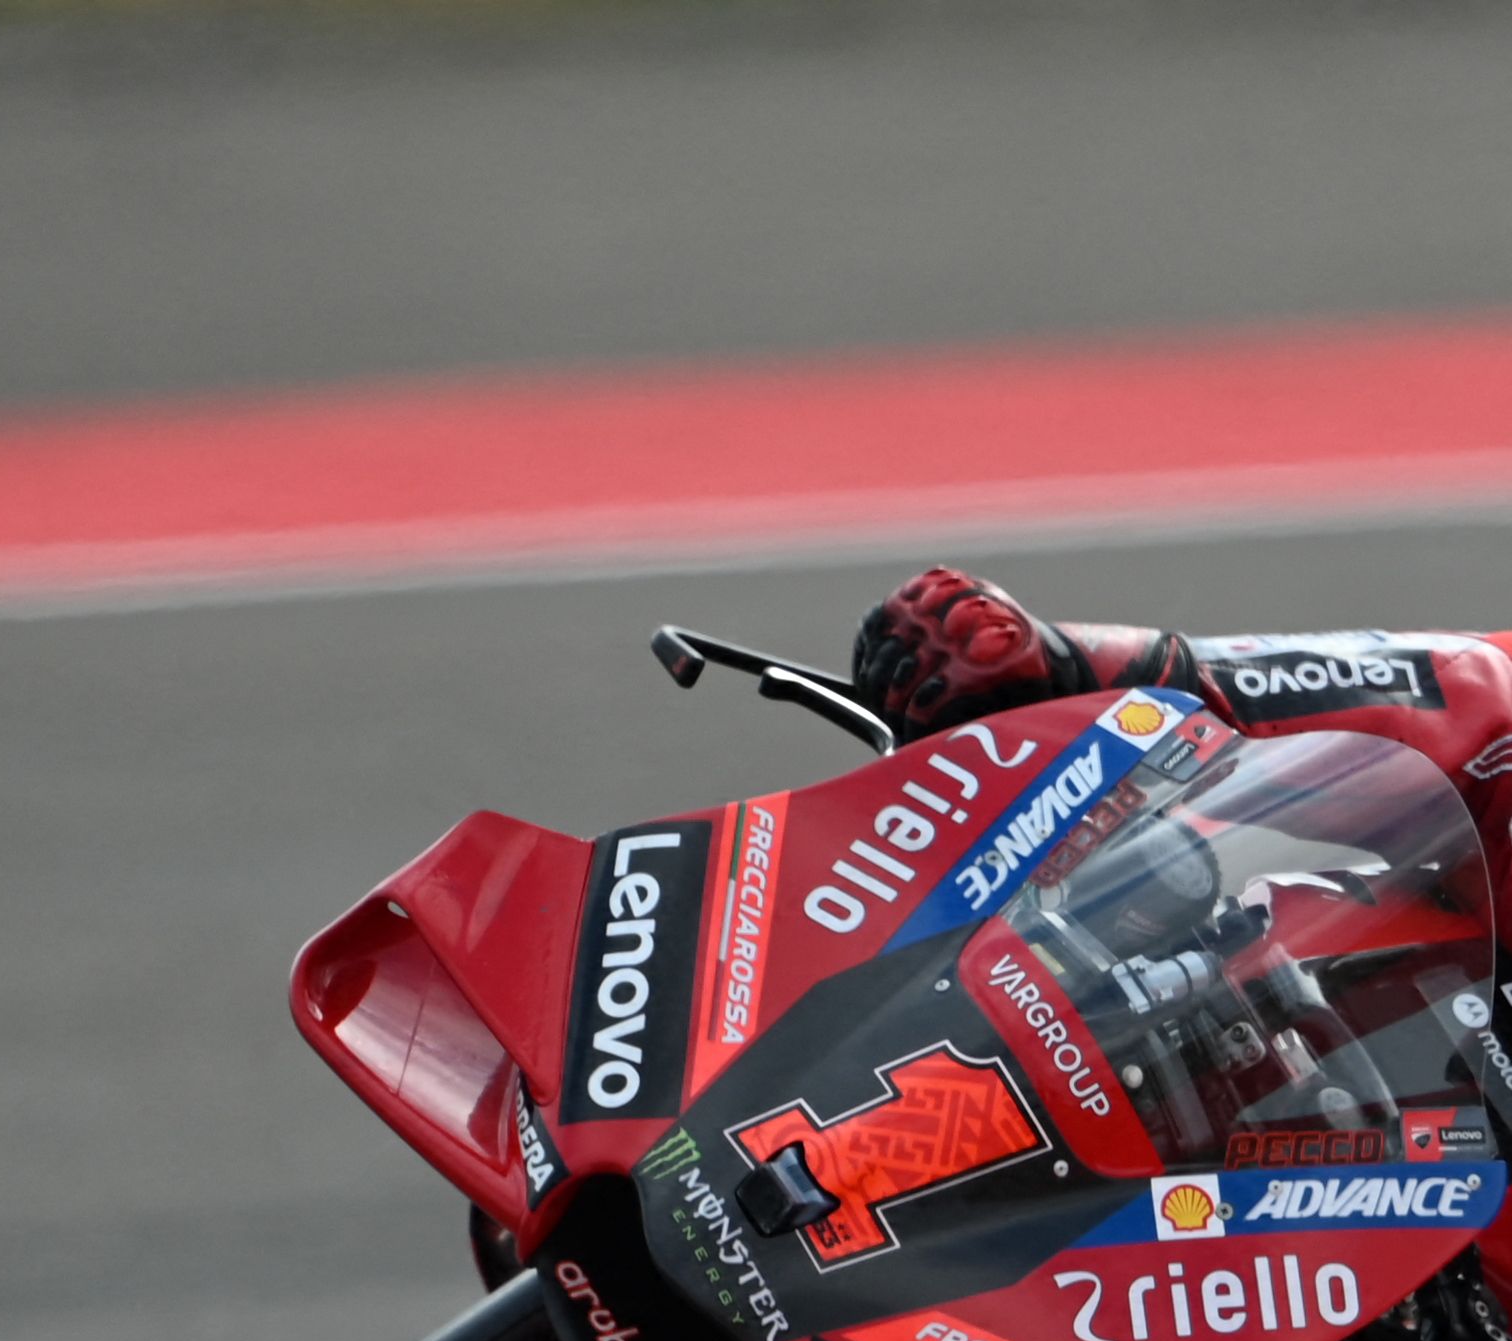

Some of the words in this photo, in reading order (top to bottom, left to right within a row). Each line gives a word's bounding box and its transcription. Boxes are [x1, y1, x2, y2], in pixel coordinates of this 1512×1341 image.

[1234, 656, 1423, 699] Lenovo
[802, 752, 980, 934] riello
[955, 741, 1104, 911] ADVANCE
[587, 832, 681, 1109] Lenovo
[721, 805, 775, 1044] FRECCIAROSSA
[989, 953, 1111, 1118] VARGROUP
[724, 1040, 1052, 1273] 1
[1224, 1130, 1386, 1169] PECCO
[1244, 1177, 1470, 1222] ADVANCE
[1441, 1129, 1483, 1141] Lenovo
[672, 1208, 745, 1324] ENERGY
[1128, 1254, 1360, 1341] riello
